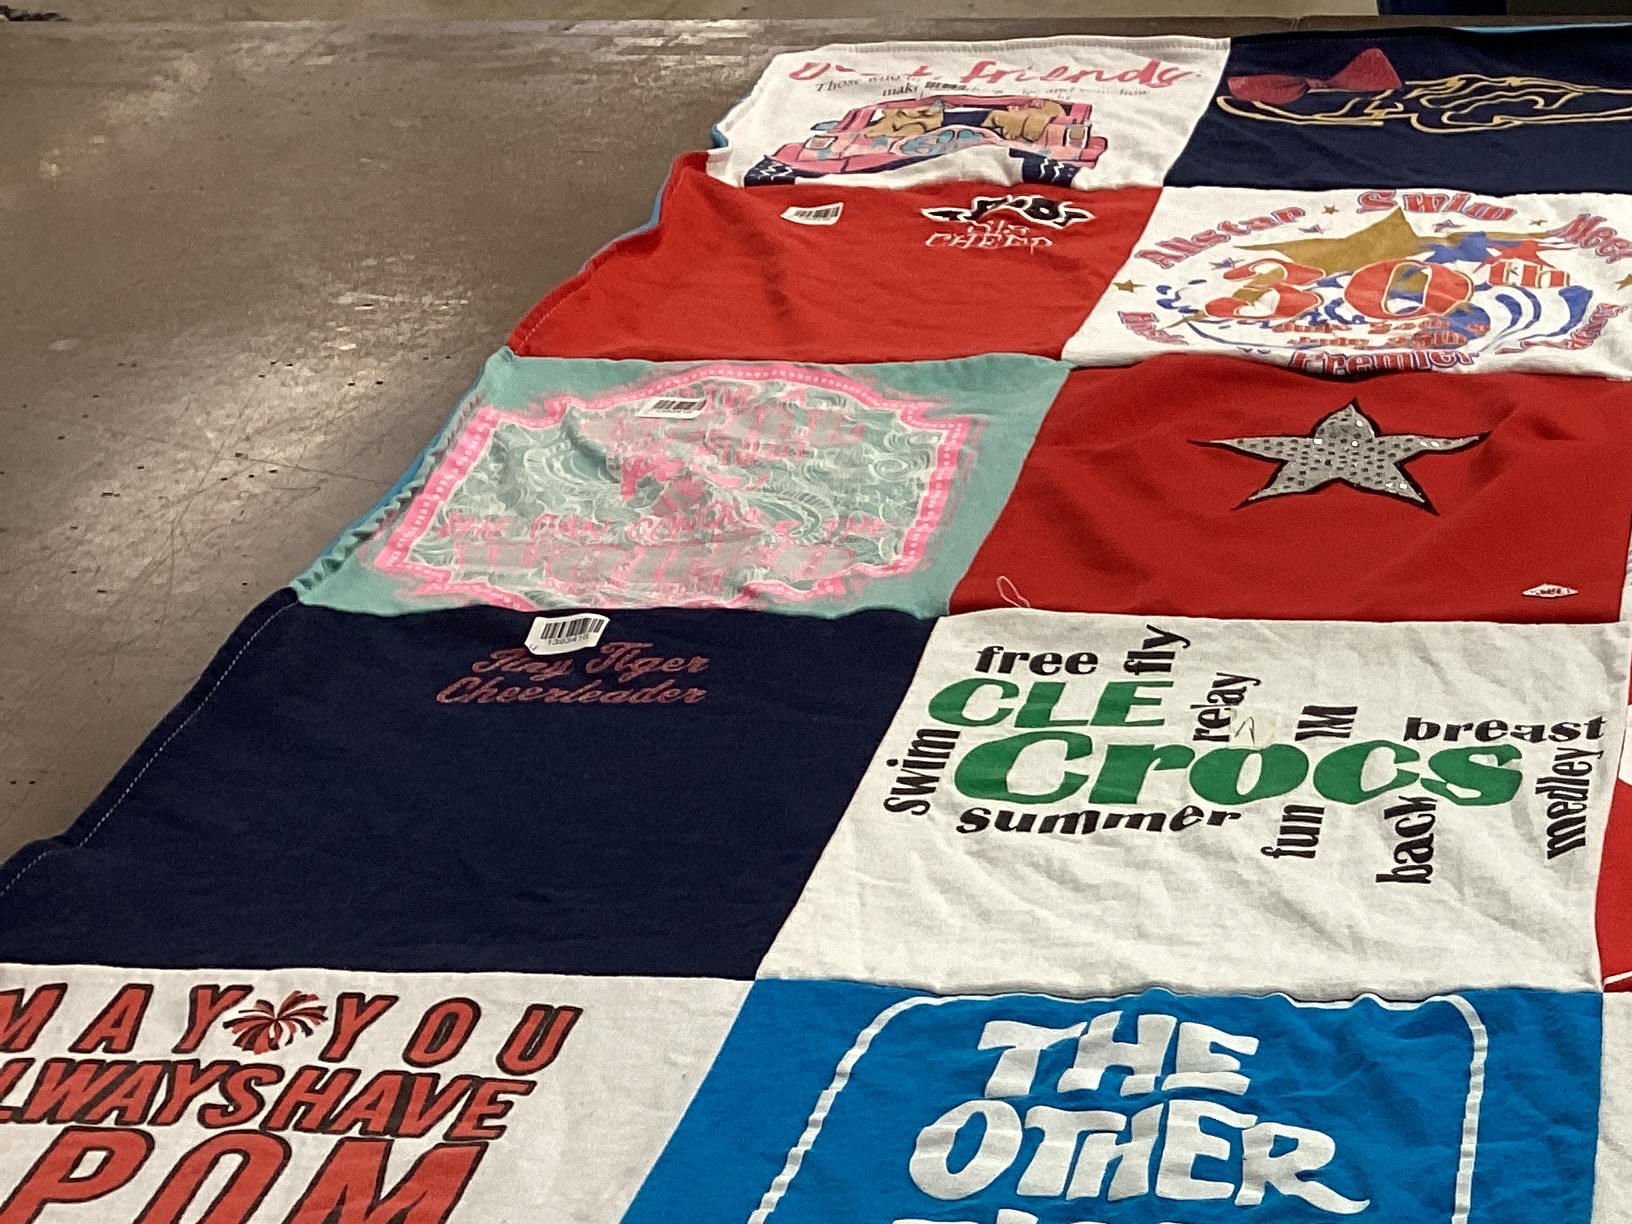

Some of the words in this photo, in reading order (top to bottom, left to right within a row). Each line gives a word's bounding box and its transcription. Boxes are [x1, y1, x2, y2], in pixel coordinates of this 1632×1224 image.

[1135, 206, 1307, 269] Allstar
[1356, 190, 1517, 223] Swim
[586, 641, 711, 683] Tiger
[975, 645, 1099, 677] free
[1123, 623, 1190, 677] fly
[436, 676, 707, 704] Cheerleader
[927, 677, 1175, 729] CLE
[1189, 671, 1262, 743] relay
[1402, 715, 1609, 743] breast
[884, 727, 962, 816] swim
[953, 730, 1524, 807] Crocs
[1534, 745, 1606, 860] medley
[955, 804, 1242, 836] summer
[1260, 803, 1326, 860] fun
[1375, 794, 1439, 885] back
[0, 983, 256, 1055] MAY
[318, 992, 584, 1076] YOU
[976, 1010, 1260, 1099] THE
[0, 1057, 284, 1130] LWAYS
[259, 1064, 539, 1142] HAVE
[908, 1097, 1372, 1216] OTHER
